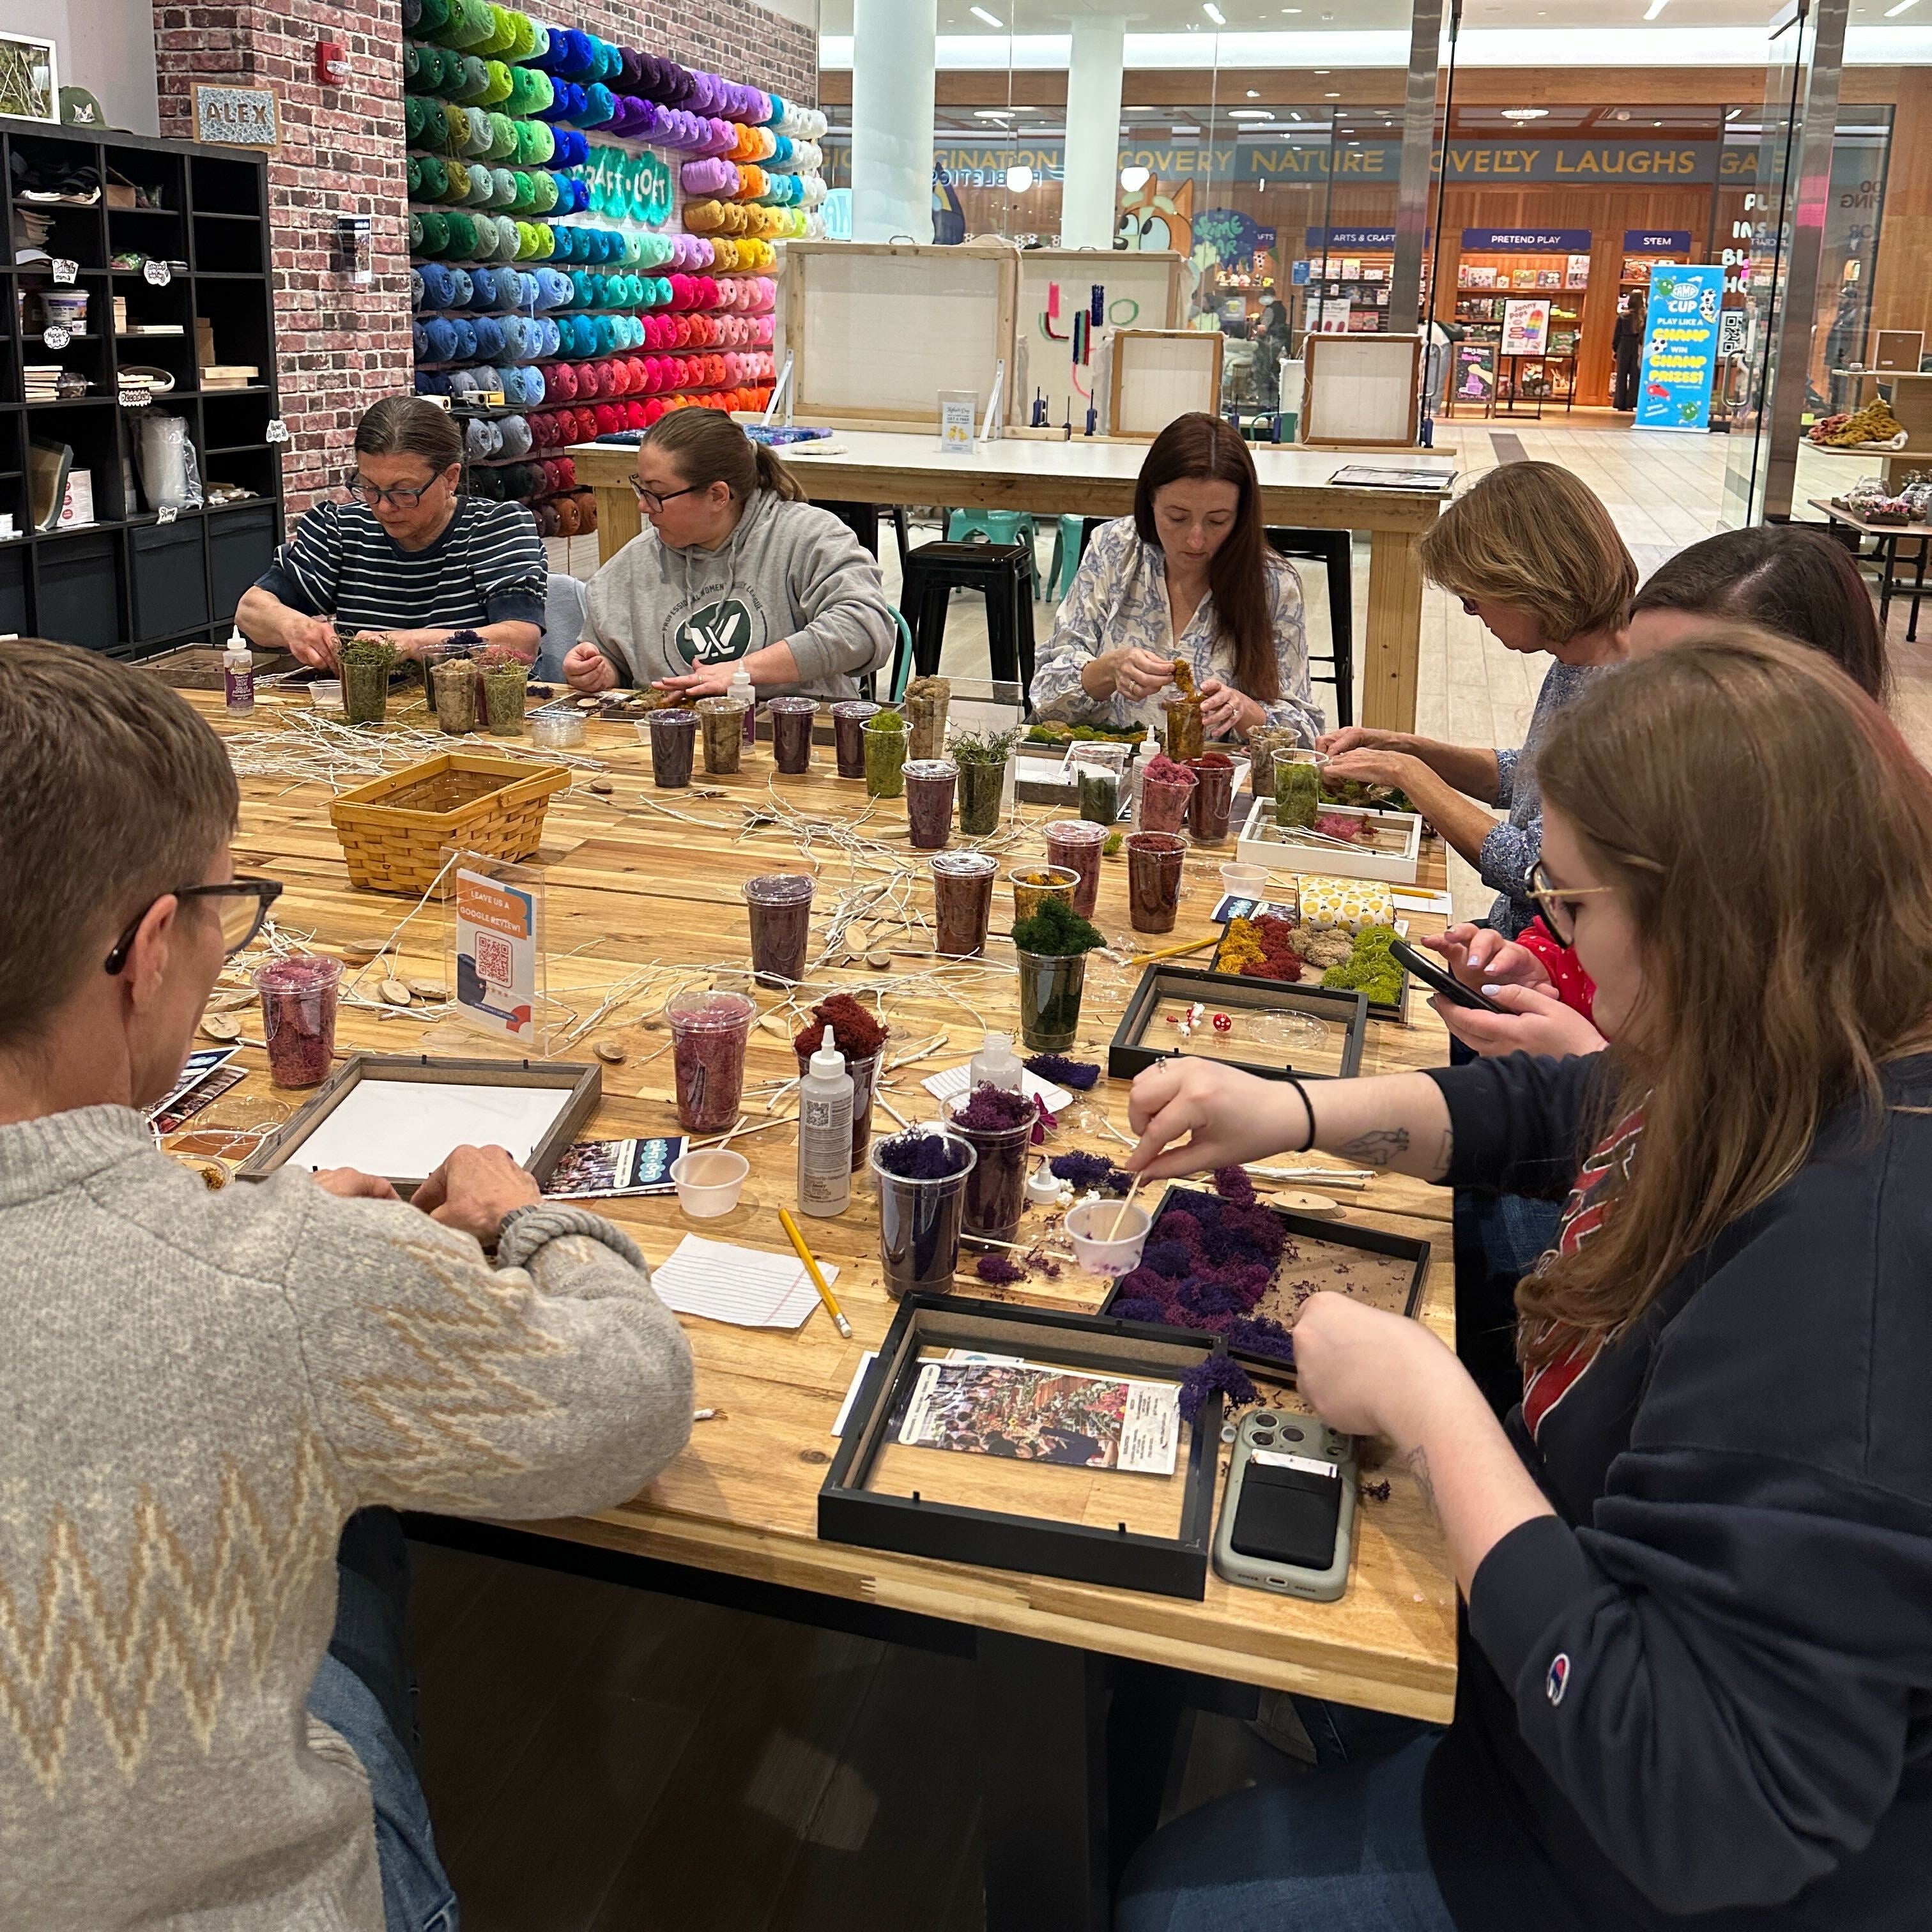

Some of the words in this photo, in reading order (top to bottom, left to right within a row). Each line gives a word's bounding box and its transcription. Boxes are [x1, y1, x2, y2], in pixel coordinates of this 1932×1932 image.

[206, 102, 266, 125] ALEX
[1118, 150, 1232, 172] COVERY
[1251, 150, 1386, 173] NATURE
[1554, 150, 1696, 174] LAUGHS
[634, 168, 665, 205] LOFT
[1333, 234, 1356, 242] ARTS
[1358, 234, 1365, 242] &
[1366, 234, 1397, 242] CRAFT
[1491, 235, 1535, 245] PRETEND
[1537, 236, 1561, 245] PLAY
[1643, 236, 1672, 247] STEM
[1216, 238, 1238, 259] AR
[1674, 285, 1697, 298] CAMP
[1667, 300, 1698, 313] CUP
[1509, 310, 1528, 319] Pops
[1652, 328, 1710, 342] CHAMP
[1650, 355, 1708, 369] CHAMP
[1648, 369, 1705, 385] PRIZES!
[662, 593, 701, 631] PROFESSIOAL
[470, 890, 493, 907] LEAVE
[493, 898, 503, 908] US
[504, 901, 510, 910] A
[460, 906, 490, 923] GOOGLE
[490, 915, 521, 933] REVIEW!
